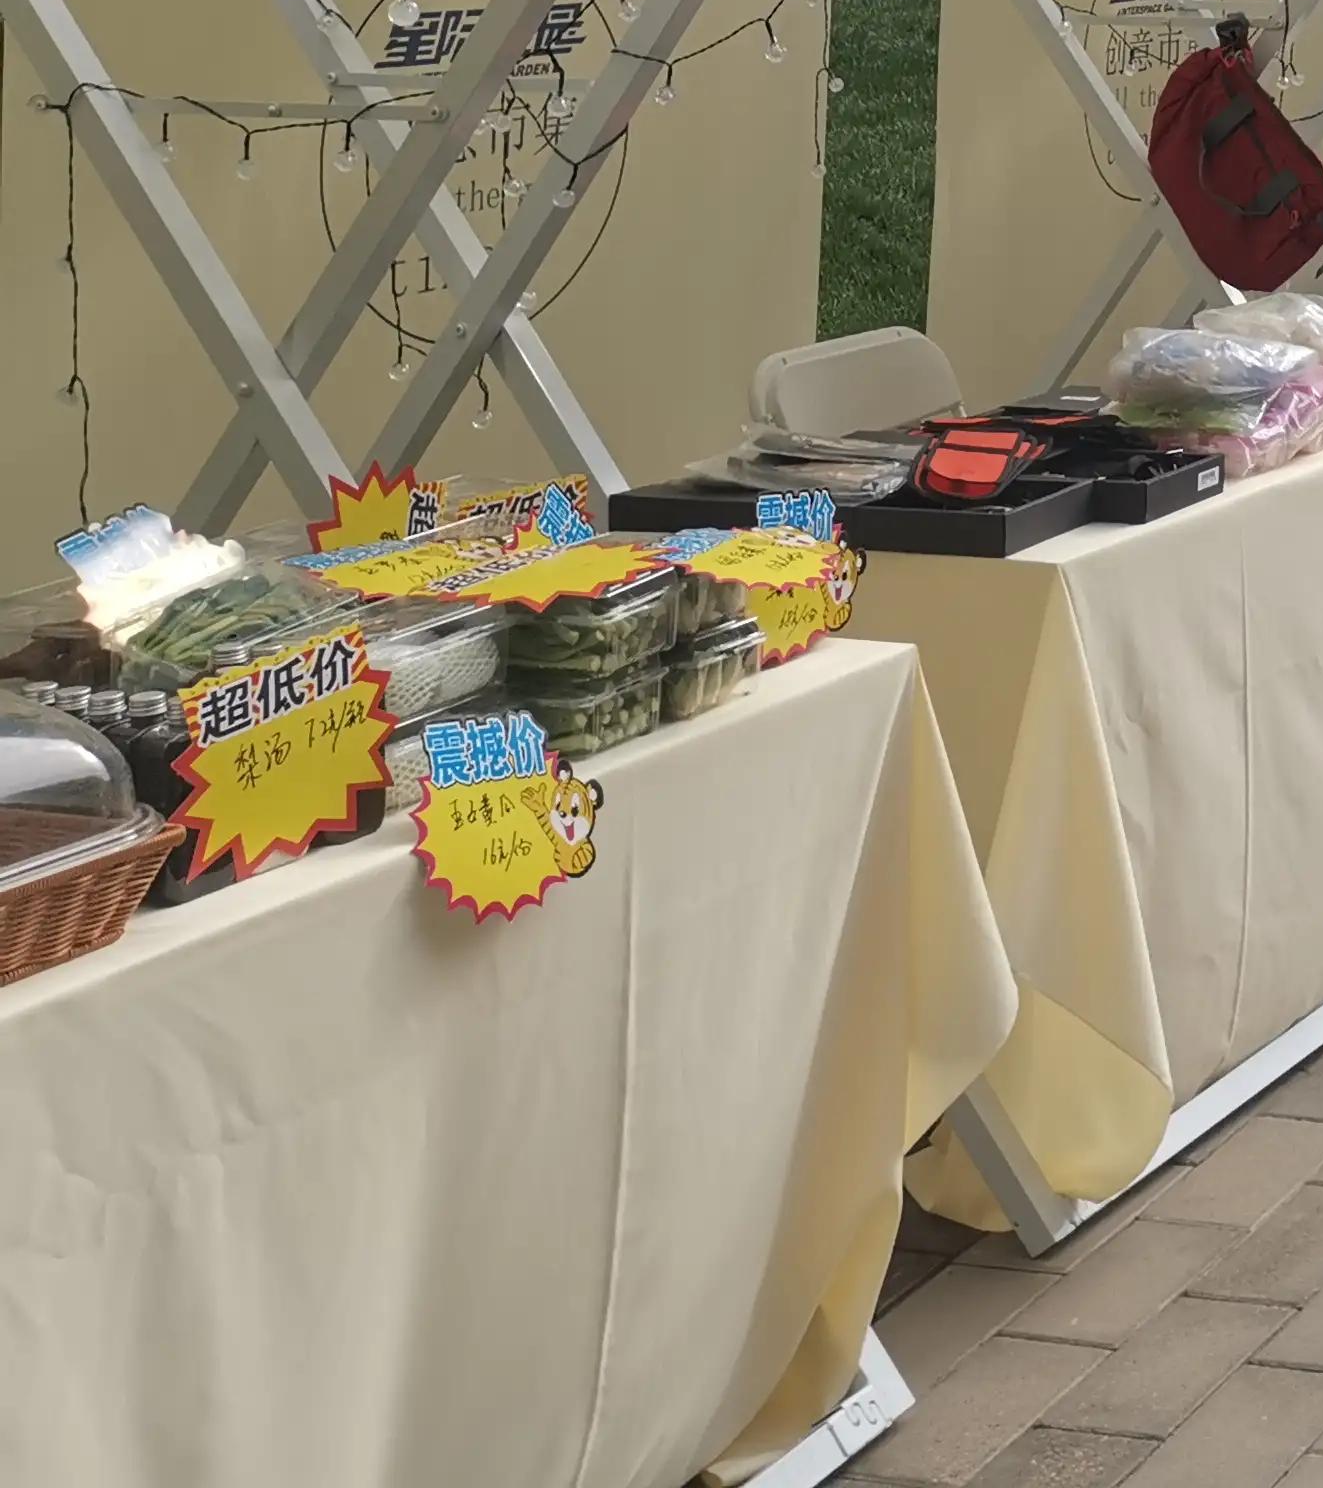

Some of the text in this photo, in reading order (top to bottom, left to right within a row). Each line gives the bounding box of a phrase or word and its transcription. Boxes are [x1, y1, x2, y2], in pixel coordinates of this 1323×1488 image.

[200, 638, 355, 745] 超低价
[424, 713, 545, 787] 震撼价
